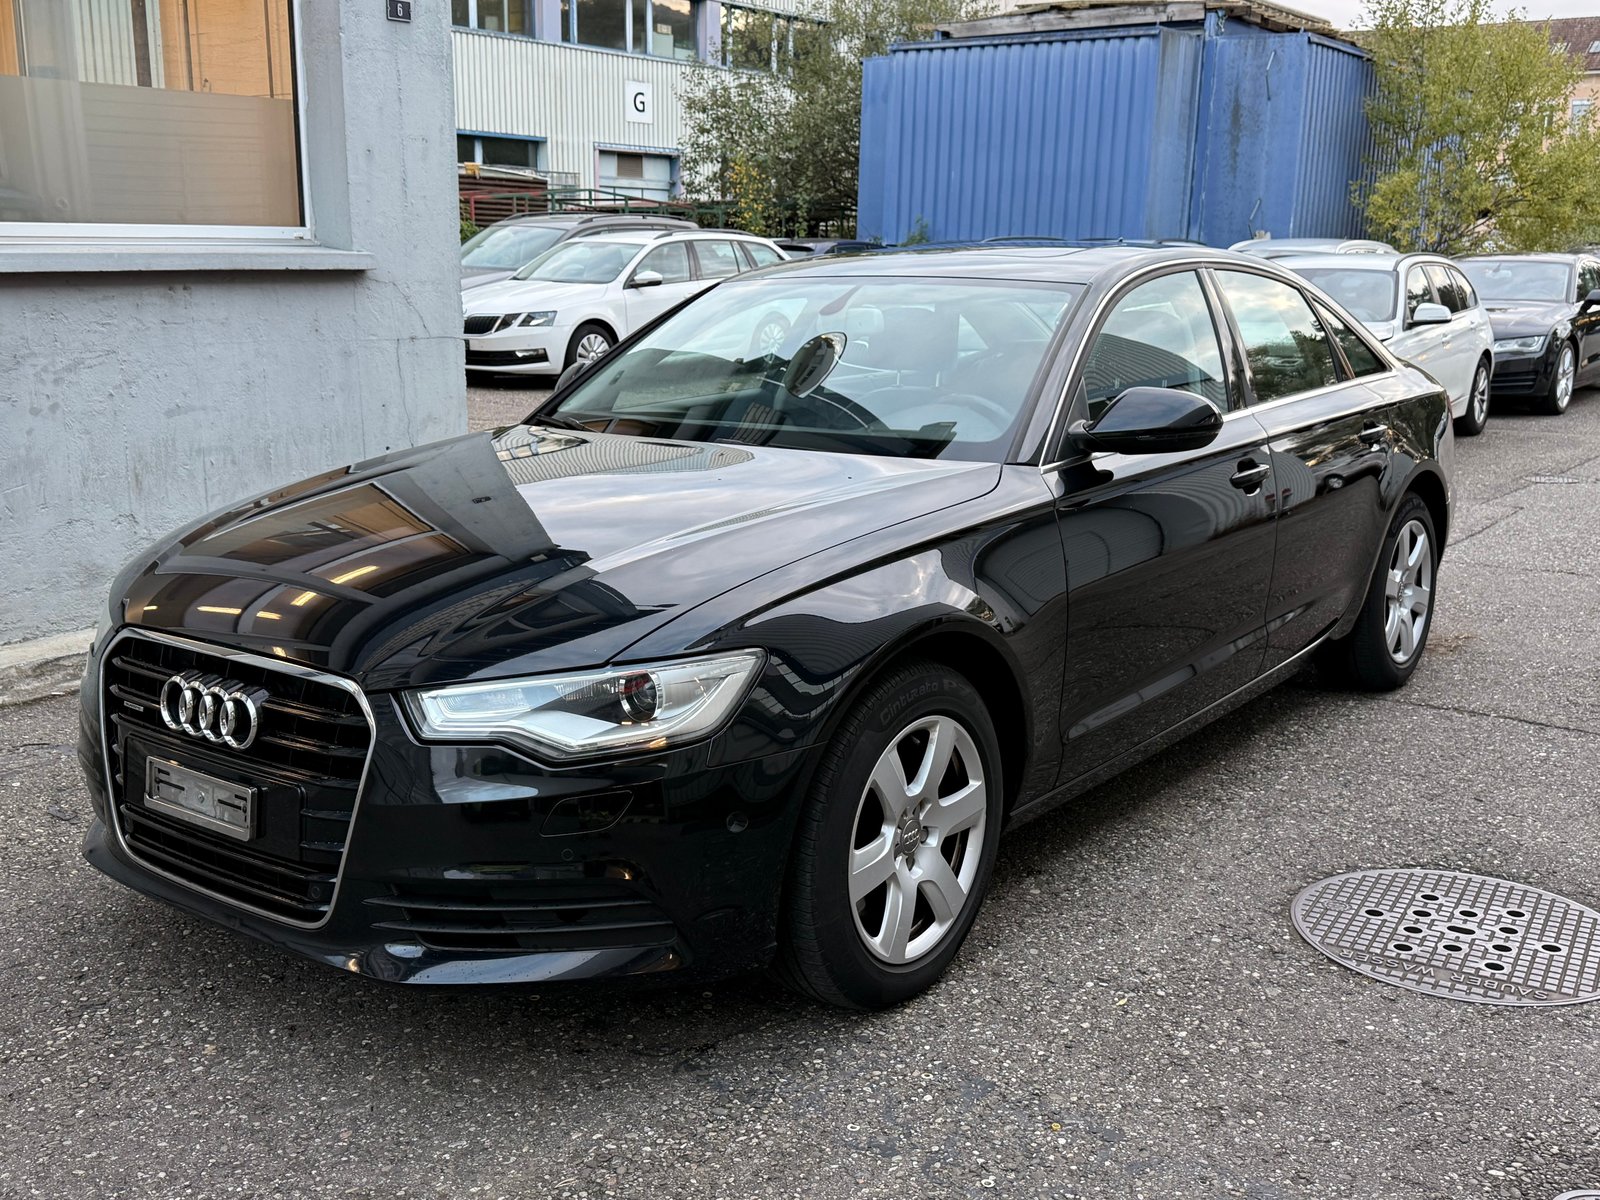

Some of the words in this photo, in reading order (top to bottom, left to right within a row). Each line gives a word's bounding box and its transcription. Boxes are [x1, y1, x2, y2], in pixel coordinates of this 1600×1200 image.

[397, 3, 403, 16] 6
[633, 92, 645, 113] G
[1339, 949, 1436, 977] WASSER
[1450, 972, 1548, 1000] SAUBER
